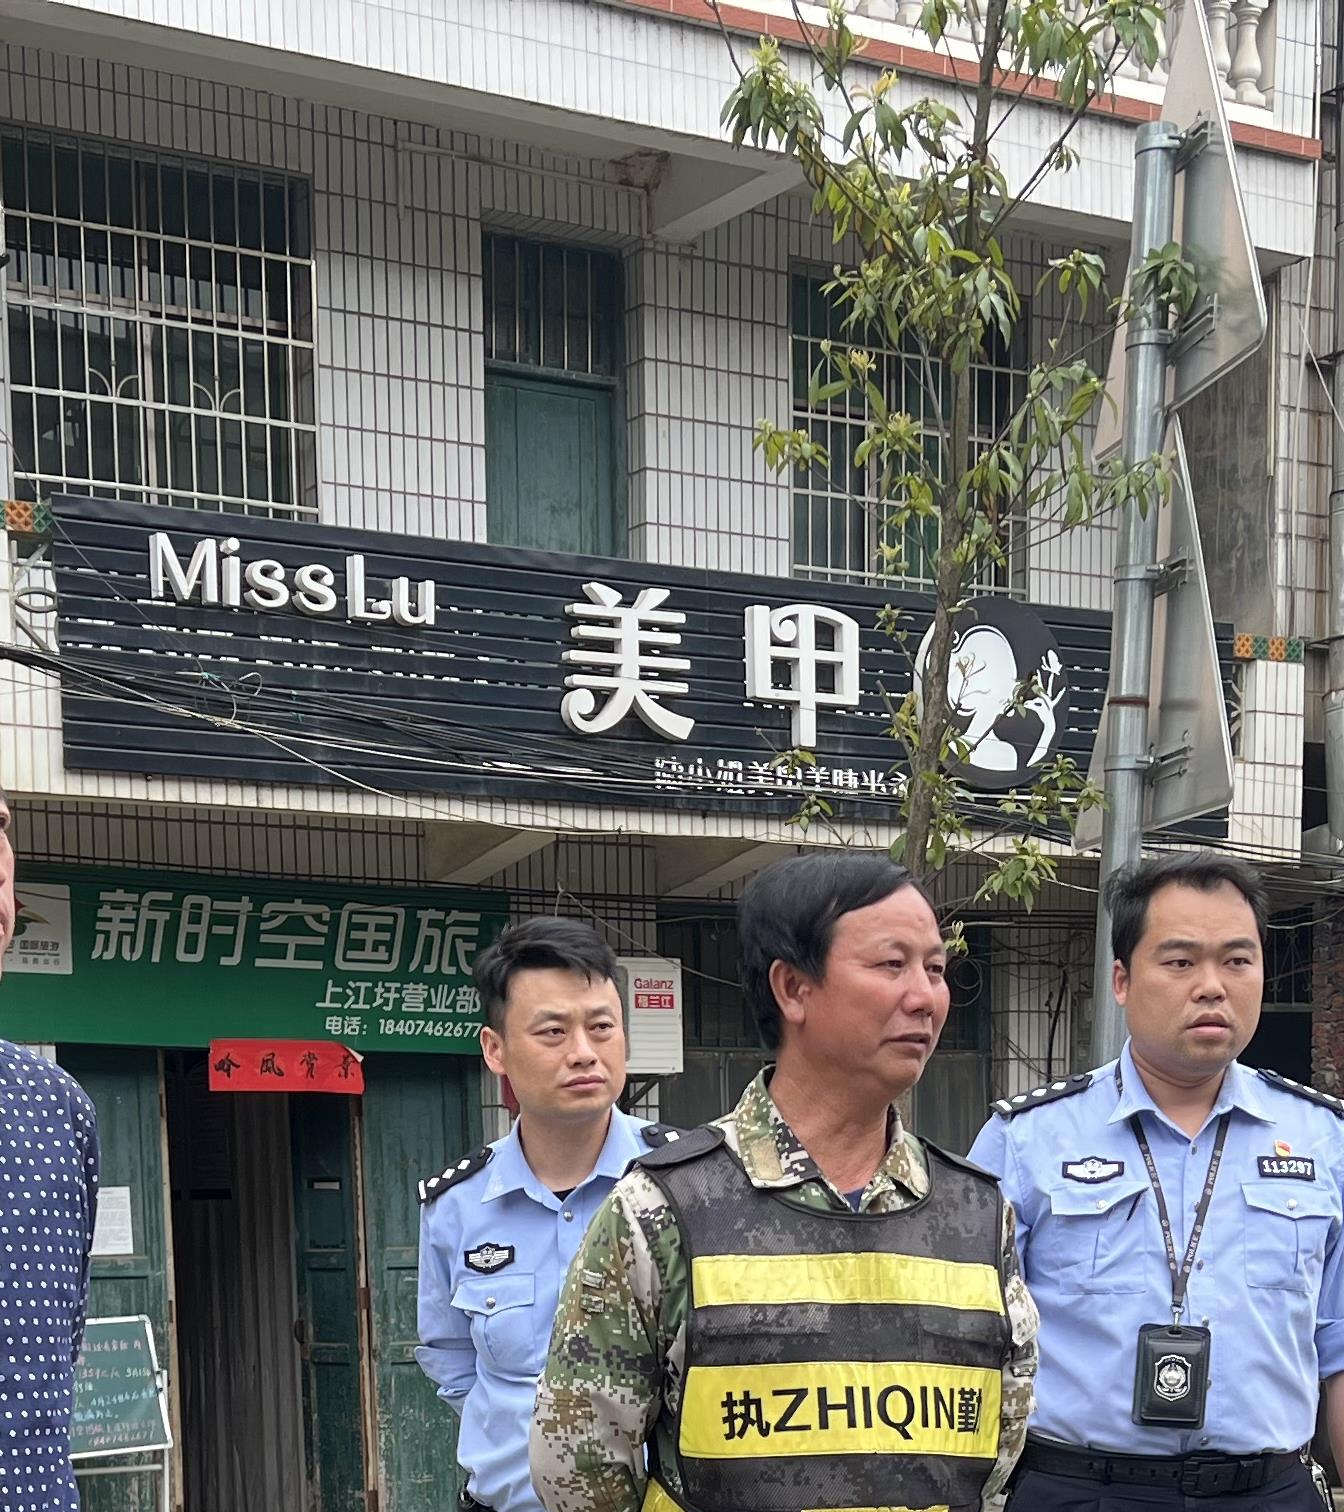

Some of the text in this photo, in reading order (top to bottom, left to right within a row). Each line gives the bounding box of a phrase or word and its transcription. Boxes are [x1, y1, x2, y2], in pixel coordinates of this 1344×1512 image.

[149, 532, 436, 626] MissLu
[561, 581, 860, 749] 美甲
[91, 889, 482, 975] 新时空国旅
[315, 979, 482, 1014] 上江圩营业部
[634, 978, 674, 990] Galanz
[378, 1018, 483, 1038] 18407462677
